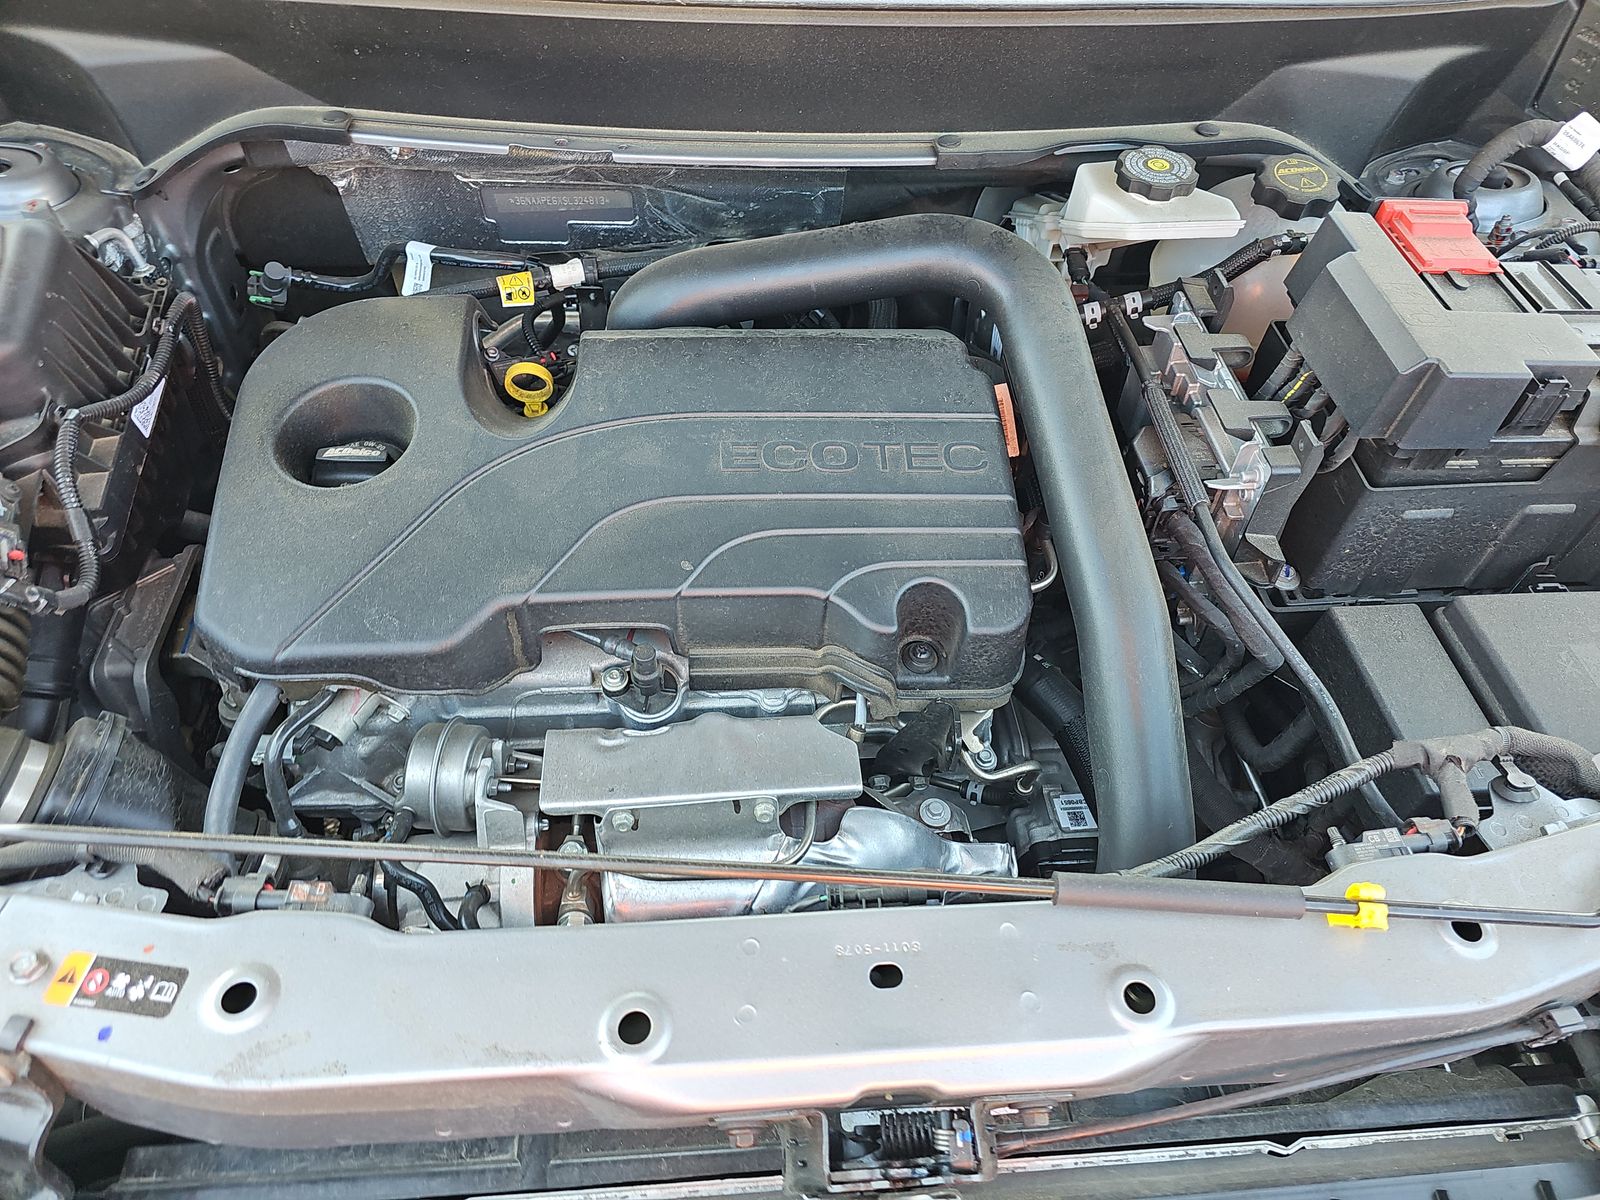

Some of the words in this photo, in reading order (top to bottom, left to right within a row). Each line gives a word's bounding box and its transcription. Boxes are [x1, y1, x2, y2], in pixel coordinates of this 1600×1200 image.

[363, 440, 386, 451] 0W-20
[322, 447, 381, 458] ACDelco
[719, 439, 989, 473] ECOTEC
